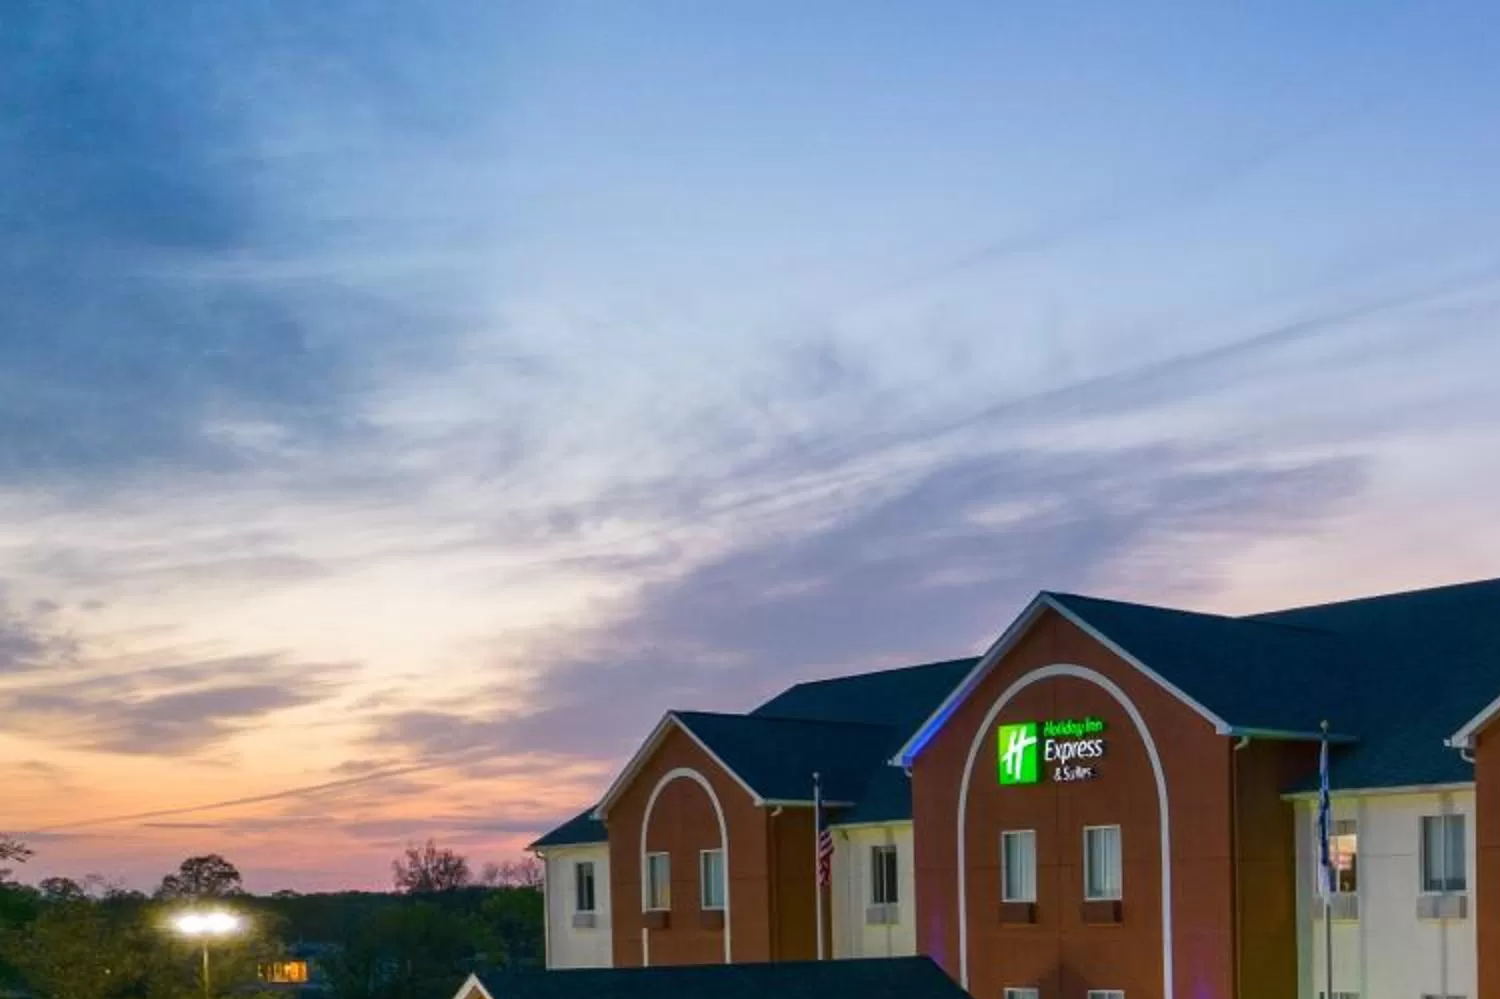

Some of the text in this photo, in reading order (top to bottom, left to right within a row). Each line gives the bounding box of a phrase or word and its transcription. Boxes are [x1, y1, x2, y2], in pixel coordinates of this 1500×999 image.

[1044, 716, 1103, 737] Holiday Inn
[1045, 739, 1103, 765] Express
